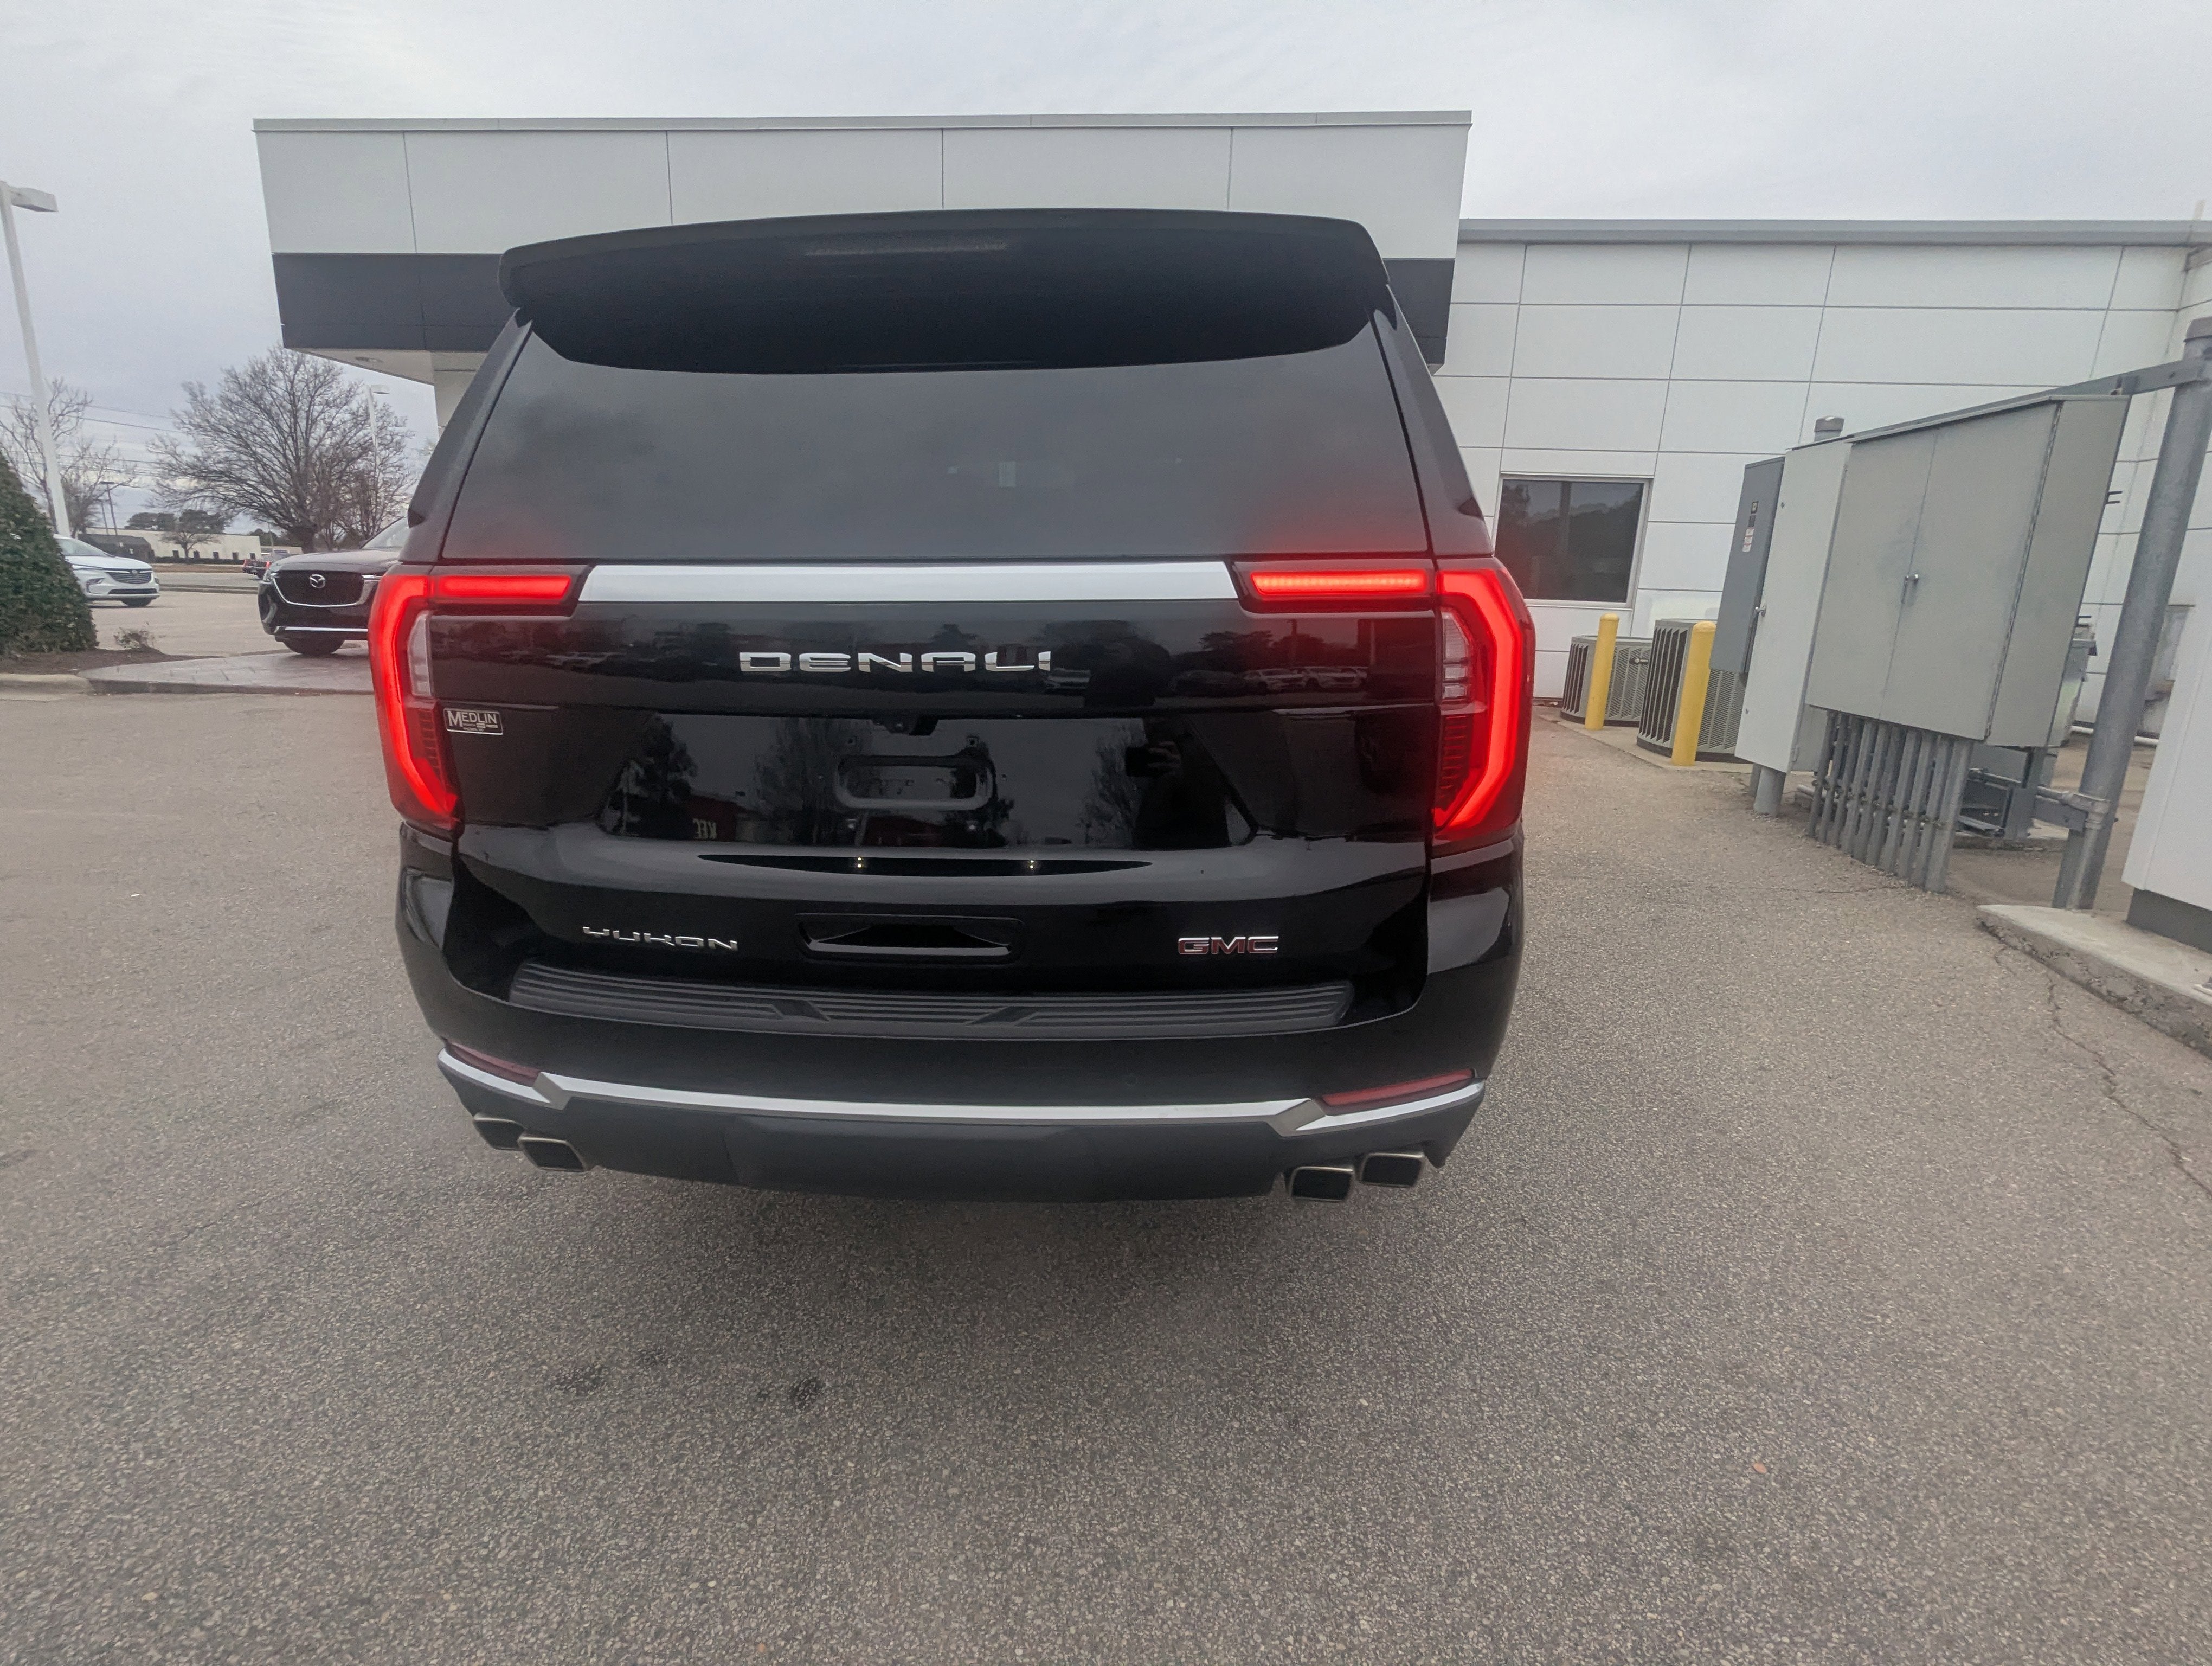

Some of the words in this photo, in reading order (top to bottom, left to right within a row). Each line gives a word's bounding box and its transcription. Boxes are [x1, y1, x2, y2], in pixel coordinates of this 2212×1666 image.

[740, 651, 1051, 672] DENALI
[447, 710, 498, 727] MEDLIN
[583, 927, 737, 951] YUKON
[1178, 936, 1279, 954] GMC
